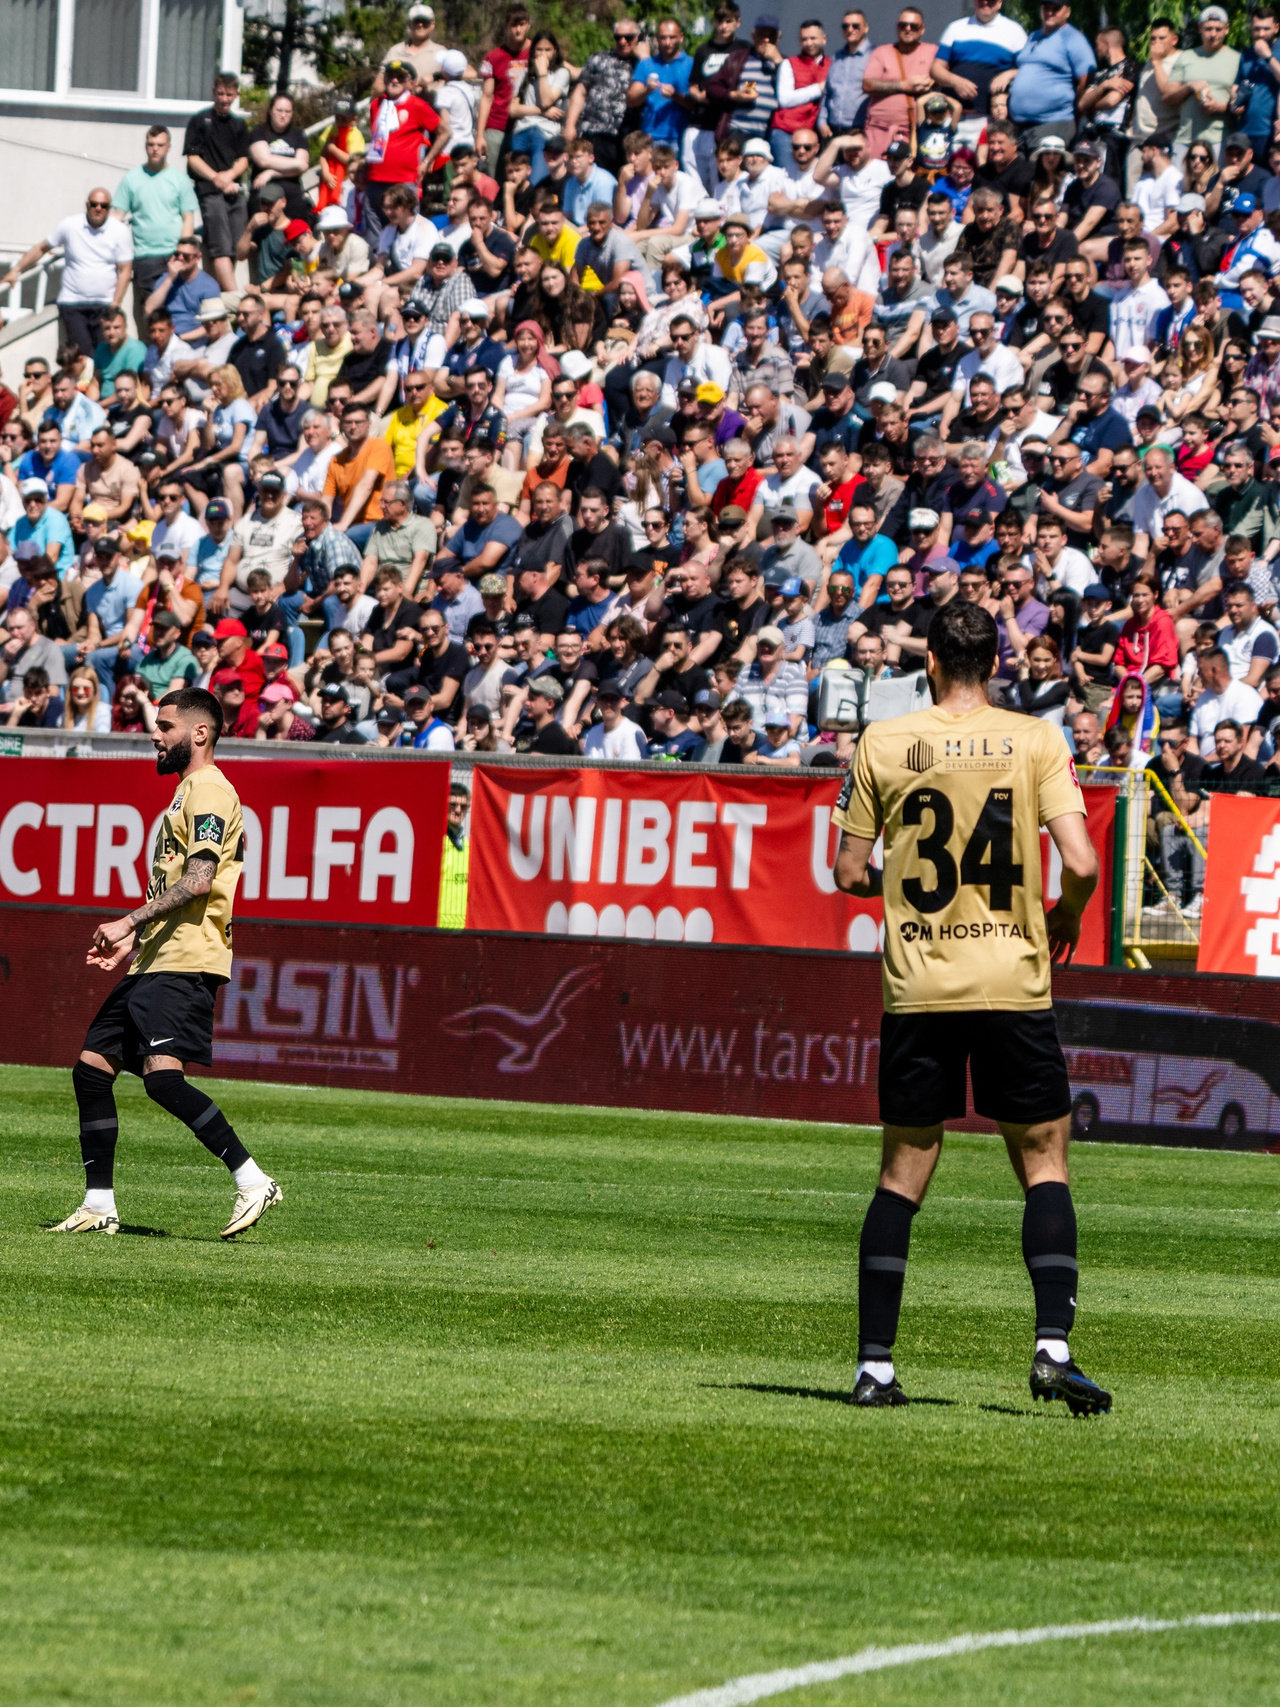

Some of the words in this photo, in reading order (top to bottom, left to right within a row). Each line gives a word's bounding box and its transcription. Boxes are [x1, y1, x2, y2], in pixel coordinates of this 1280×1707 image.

[945, 737, 1013, 757] HILS
[945, 761, 1013, 769] DEVELOPMENT
[507, 794, 767, 890] UNIBET
[902, 788, 1024, 914] 34
[940, 923, 1032, 940] HOSPITAL
